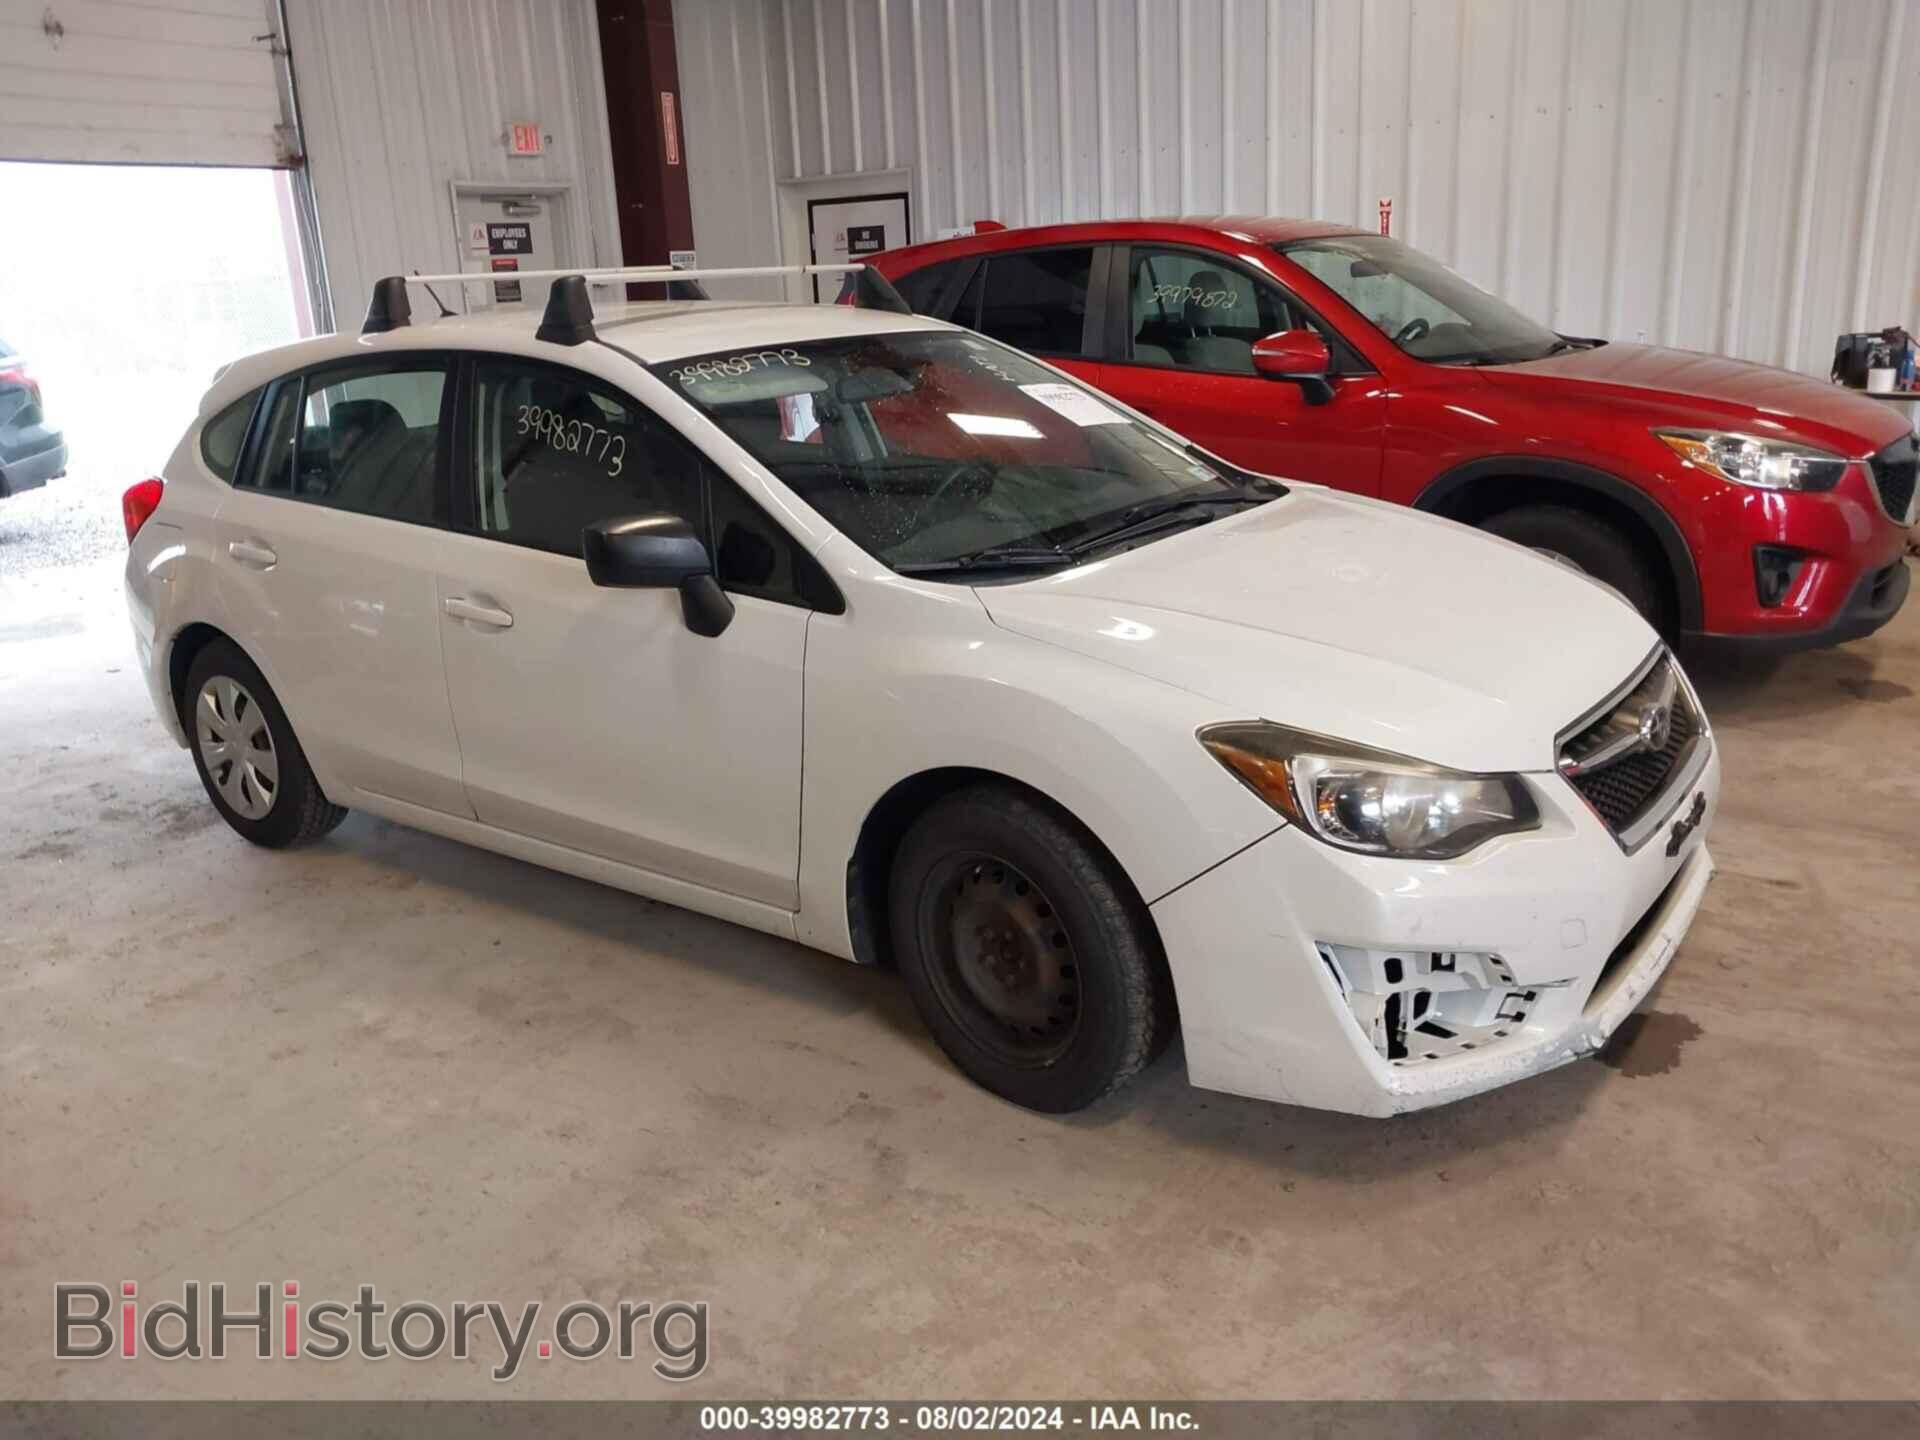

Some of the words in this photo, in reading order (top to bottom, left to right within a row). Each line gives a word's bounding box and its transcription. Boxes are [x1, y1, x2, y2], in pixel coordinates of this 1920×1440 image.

[514, 123, 541, 152] EXIT
[491, 228, 527, 239] EMPLOYEES
[502, 239, 519, 250] ONLY
[669, 349, 812, 385] 39982773
[517, 405, 625, 476] 39982773
